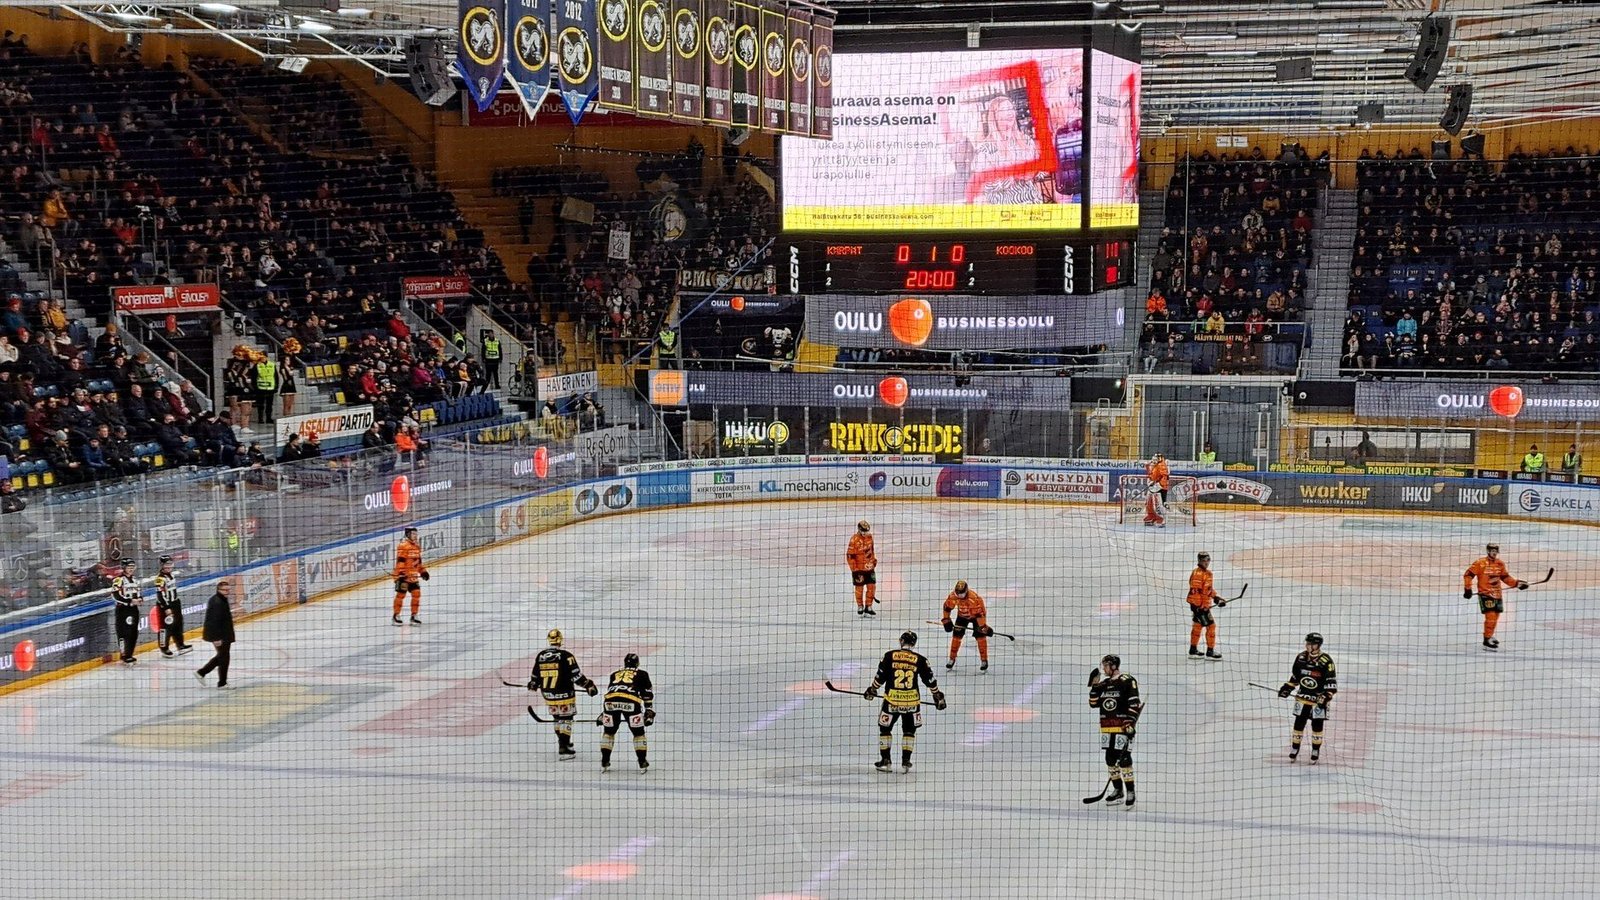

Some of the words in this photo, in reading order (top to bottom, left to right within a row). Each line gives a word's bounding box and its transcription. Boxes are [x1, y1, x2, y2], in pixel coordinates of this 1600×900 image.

[565, 1, 582, 20] 2012
[832, 96, 880, 107] uraava
[884, 97, 933, 106] asema
[937, 96, 956, 106] on
[832, 113, 937, 126] sinessAsema!
[898, 245, 909, 262] 0
[931, 246, 937, 261] 1
[952, 245, 963, 262] 0
[996, 246, 1033, 255] KOOKOO
[790, 246, 799, 294] CCM
[826, 263, 831, 271] 1
[969, 263, 974, 271] 1
[1064, 245, 1074, 294] CCM
[826, 277, 832, 286] 2
[906, 271, 955, 287] 20:00
[968, 277, 975, 286] 2
[118, 291, 165, 309] pohjanmaan
[834, 311, 882, 331] OULU
[938, 316, 1054, 328] BUSINESSOULU
[546, 373, 591, 392] HAVERINEN
[833, 384, 875, 398] OULU
[910, 388, 988, 397] BUSINESSOULU
[1437, 394, 1484, 408] OULU
[1526, 398, 1600, 407] BUSINESSOU
[725, 421, 766, 440] IHKU
[830, 422, 887, 451] RINK
[902, 424, 962, 453] SIDE
[1026, 472, 1104, 484] KIVISYDÄN
[1368, 466, 1430, 476] PANCHOVILLA.FI
[758, 481, 782, 492] KL
[784, 480, 851, 492] mechanics
[892, 476, 931, 487] OULU
[1036, 484, 1093, 492] TERVETULOA!
[1229, 480, 1261, 497] ässä
[1300, 481, 1370, 500] worker
[1401, 486, 1431, 503] IHKU
[1458, 488, 1488, 505] IHKU
[365, 494, 390, 509] OULU
[608, 494, 627, 507] IKH
[1543, 498, 1593, 510] SAKELA
[321, 544, 390, 580] INTERSPORT
[35, 637, 84, 656] BUSINESSOULU
[539, 670, 559, 689] 77
[894, 669, 914, 689] 23
